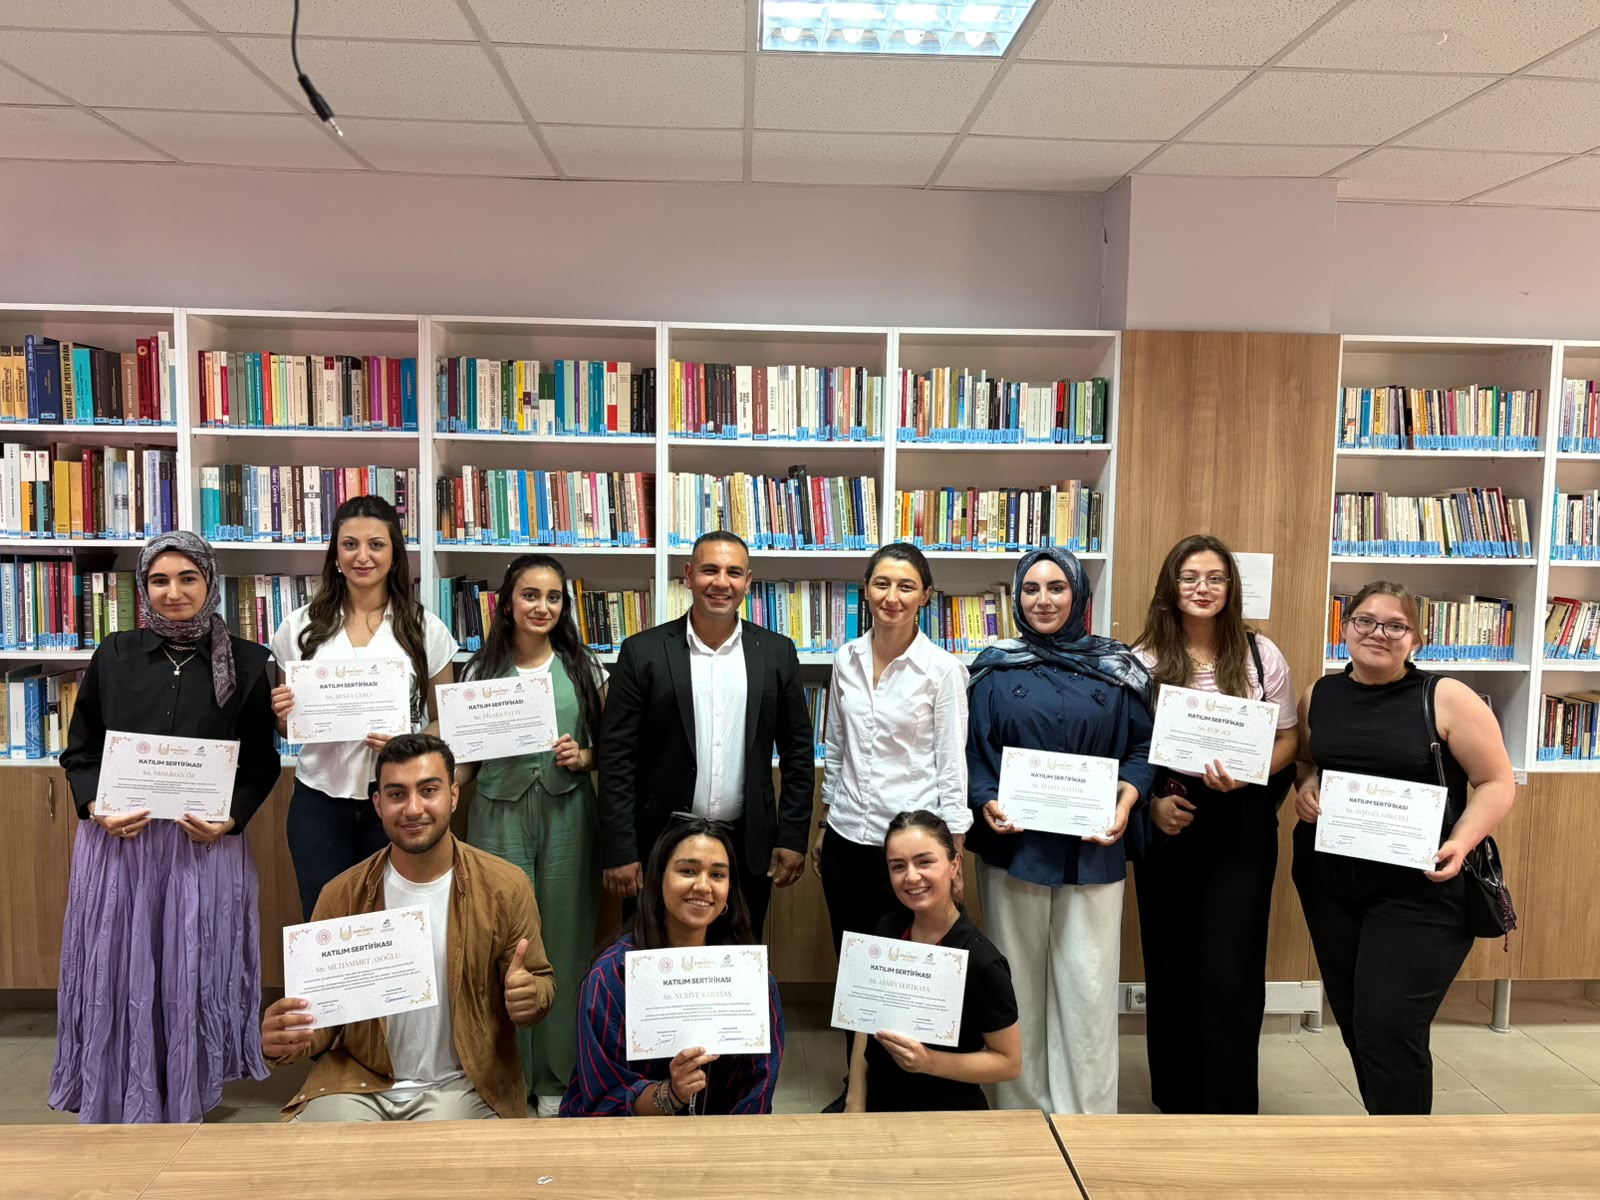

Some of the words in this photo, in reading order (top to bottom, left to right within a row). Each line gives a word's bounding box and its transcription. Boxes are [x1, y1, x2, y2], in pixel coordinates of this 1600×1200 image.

[492, 699, 524, 708] SERTİFİKASI
[1188, 713, 1211, 722] KATILIM
[1212, 717, 1245, 727] SERTİFİKASI
[1373, 800, 1408, 810] SERTİFİKASI
[321, 948, 350, 958] KATILIM
[351, 940, 392, 953] SERTİFİKASI
[328, 958, 371, 972] MUHAMMET
[373, 952, 400, 965] ASOĞLU
[870, 964, 895, 974] KATILIM
[896, 968, 931, 979] SERTİFİKASI
[691, 976, 732, 985] SERTİFİKASI
[675, 990, 701, 999] NURİYE
